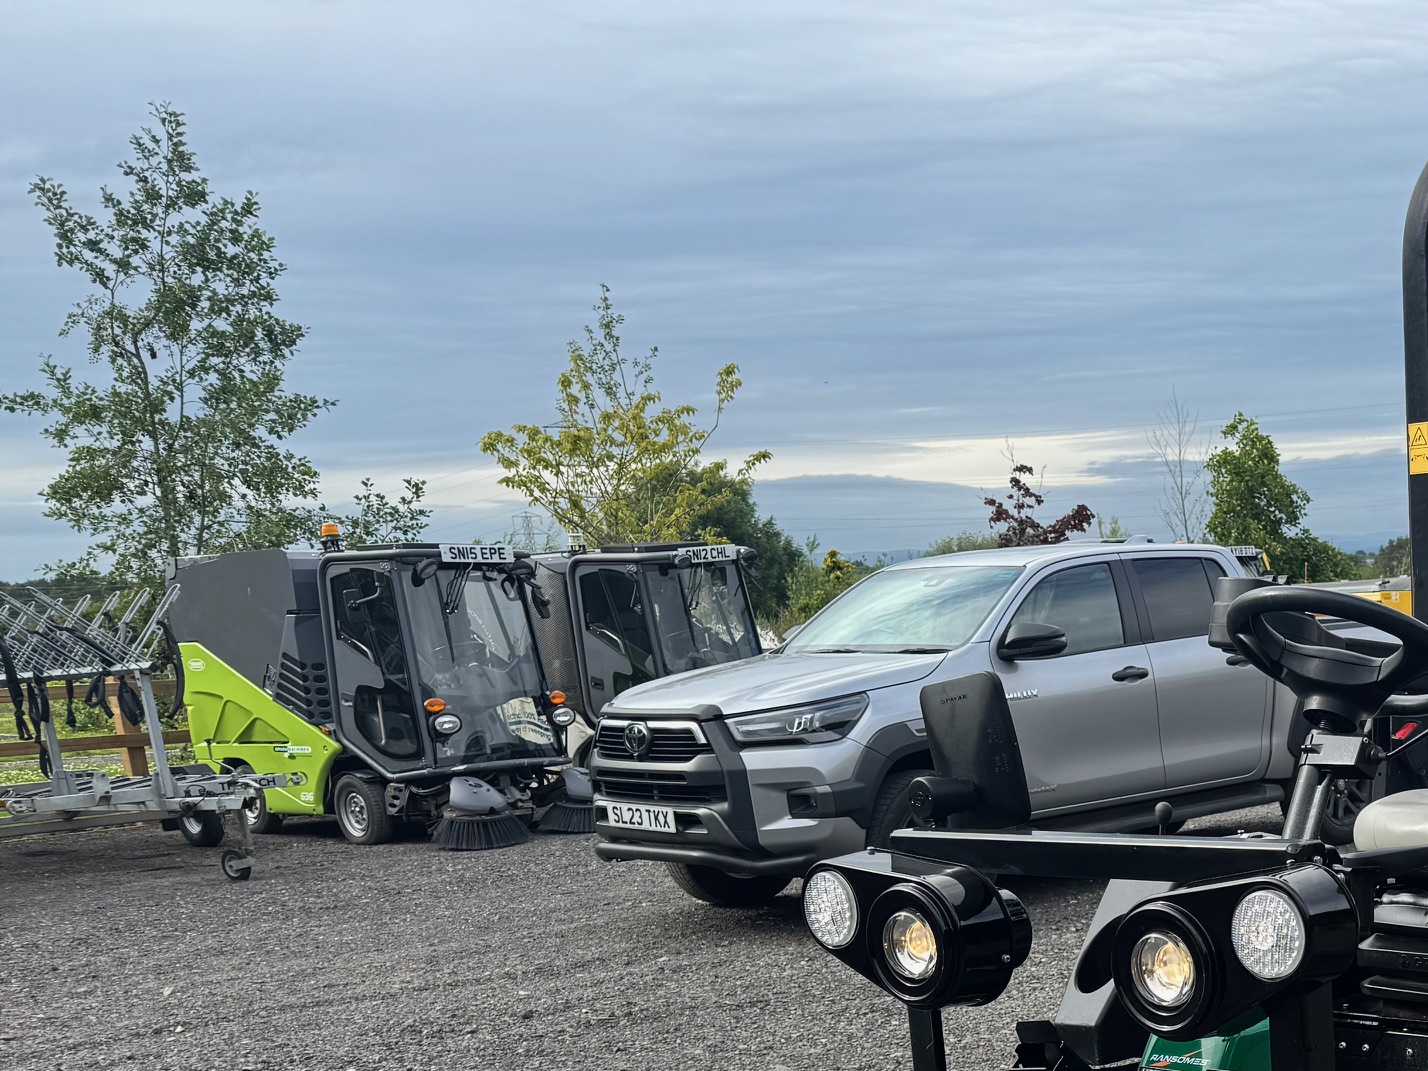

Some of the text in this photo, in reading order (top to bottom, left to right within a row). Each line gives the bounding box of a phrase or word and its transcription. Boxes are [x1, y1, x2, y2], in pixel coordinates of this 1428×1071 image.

[449, 546, 507, 560] SN15 EPE
[685, 546, 731, 561] SN12 CHL
[612, 806, 671, 829] SL23 TKX
[1149, 1054, 1211, 1066] RANSOMES
